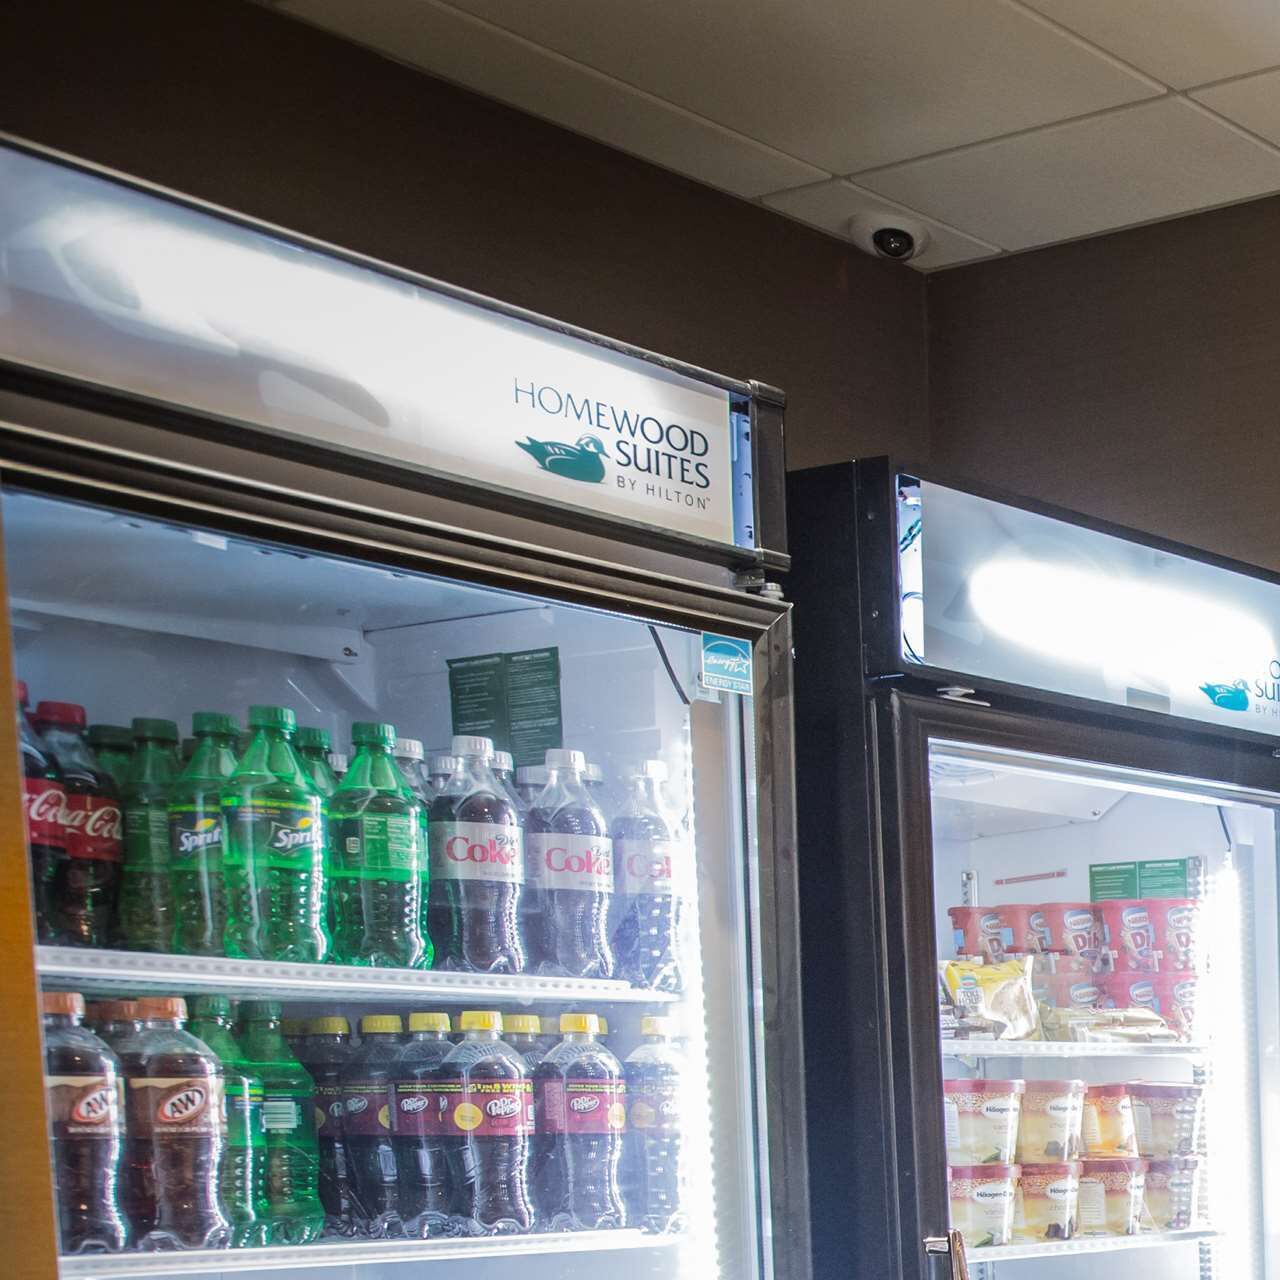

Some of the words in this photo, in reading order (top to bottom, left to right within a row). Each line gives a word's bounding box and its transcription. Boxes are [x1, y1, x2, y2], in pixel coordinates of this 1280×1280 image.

[514, 377, 709, 458] HOMEWOOD
[616, 440, 710, 489] SUITES
[617, 475, 637, 491] BY
[646, 483, 707, 511] HILTON
[1255, 704, 1267, 714] BY
[545, 847, 611, 876] Coke
